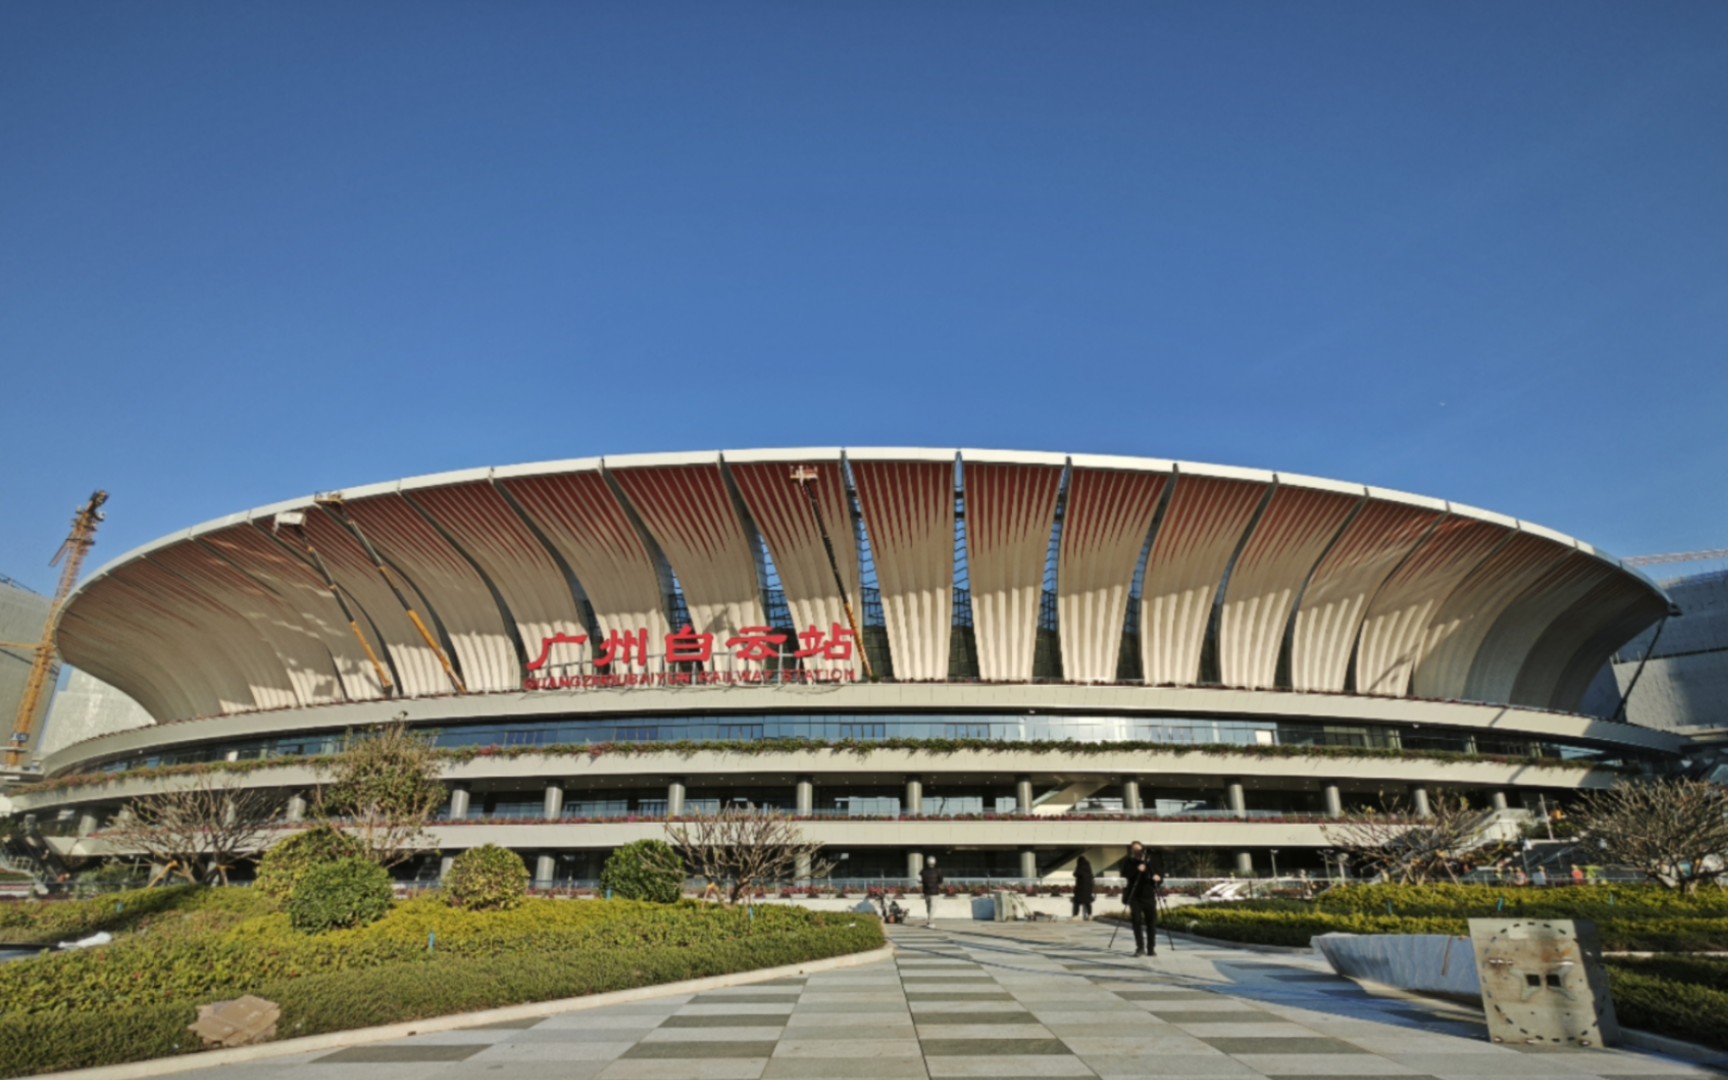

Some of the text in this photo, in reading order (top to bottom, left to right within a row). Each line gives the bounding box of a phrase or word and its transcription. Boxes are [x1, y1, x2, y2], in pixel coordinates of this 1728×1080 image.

[526, 622, 856, 671] 广州白云站
[699, 669, 774, 685] RAILWAY
[782, 668, 856, 683] STATION
